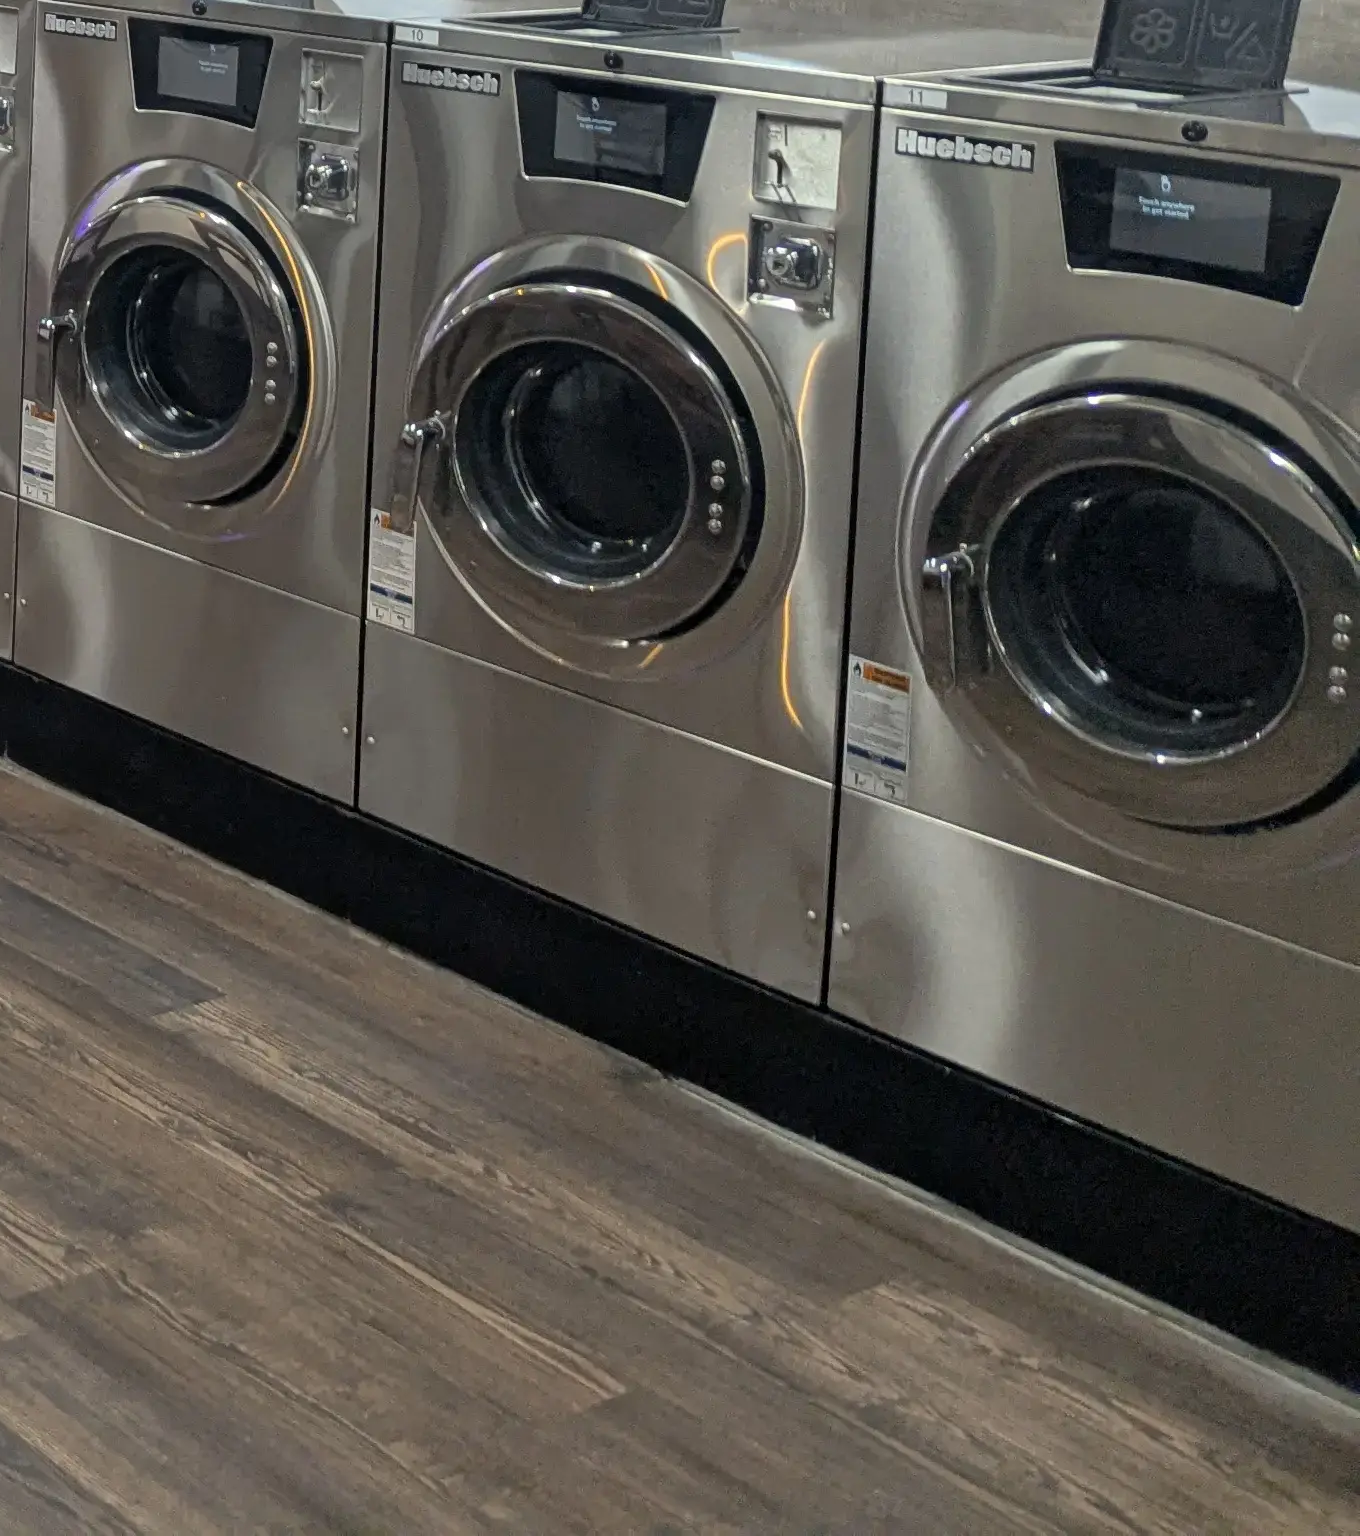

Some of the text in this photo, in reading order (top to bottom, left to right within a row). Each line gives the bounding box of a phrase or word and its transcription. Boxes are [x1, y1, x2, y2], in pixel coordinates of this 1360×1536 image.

[44, 13, 116, 39] Huebsch
[411, 29, 424, 42] 10
[402, 62, 499, 94] Huebsch
[908, 88, 923, 103] 11
[896, 128, 1033, 168] Huebsch
